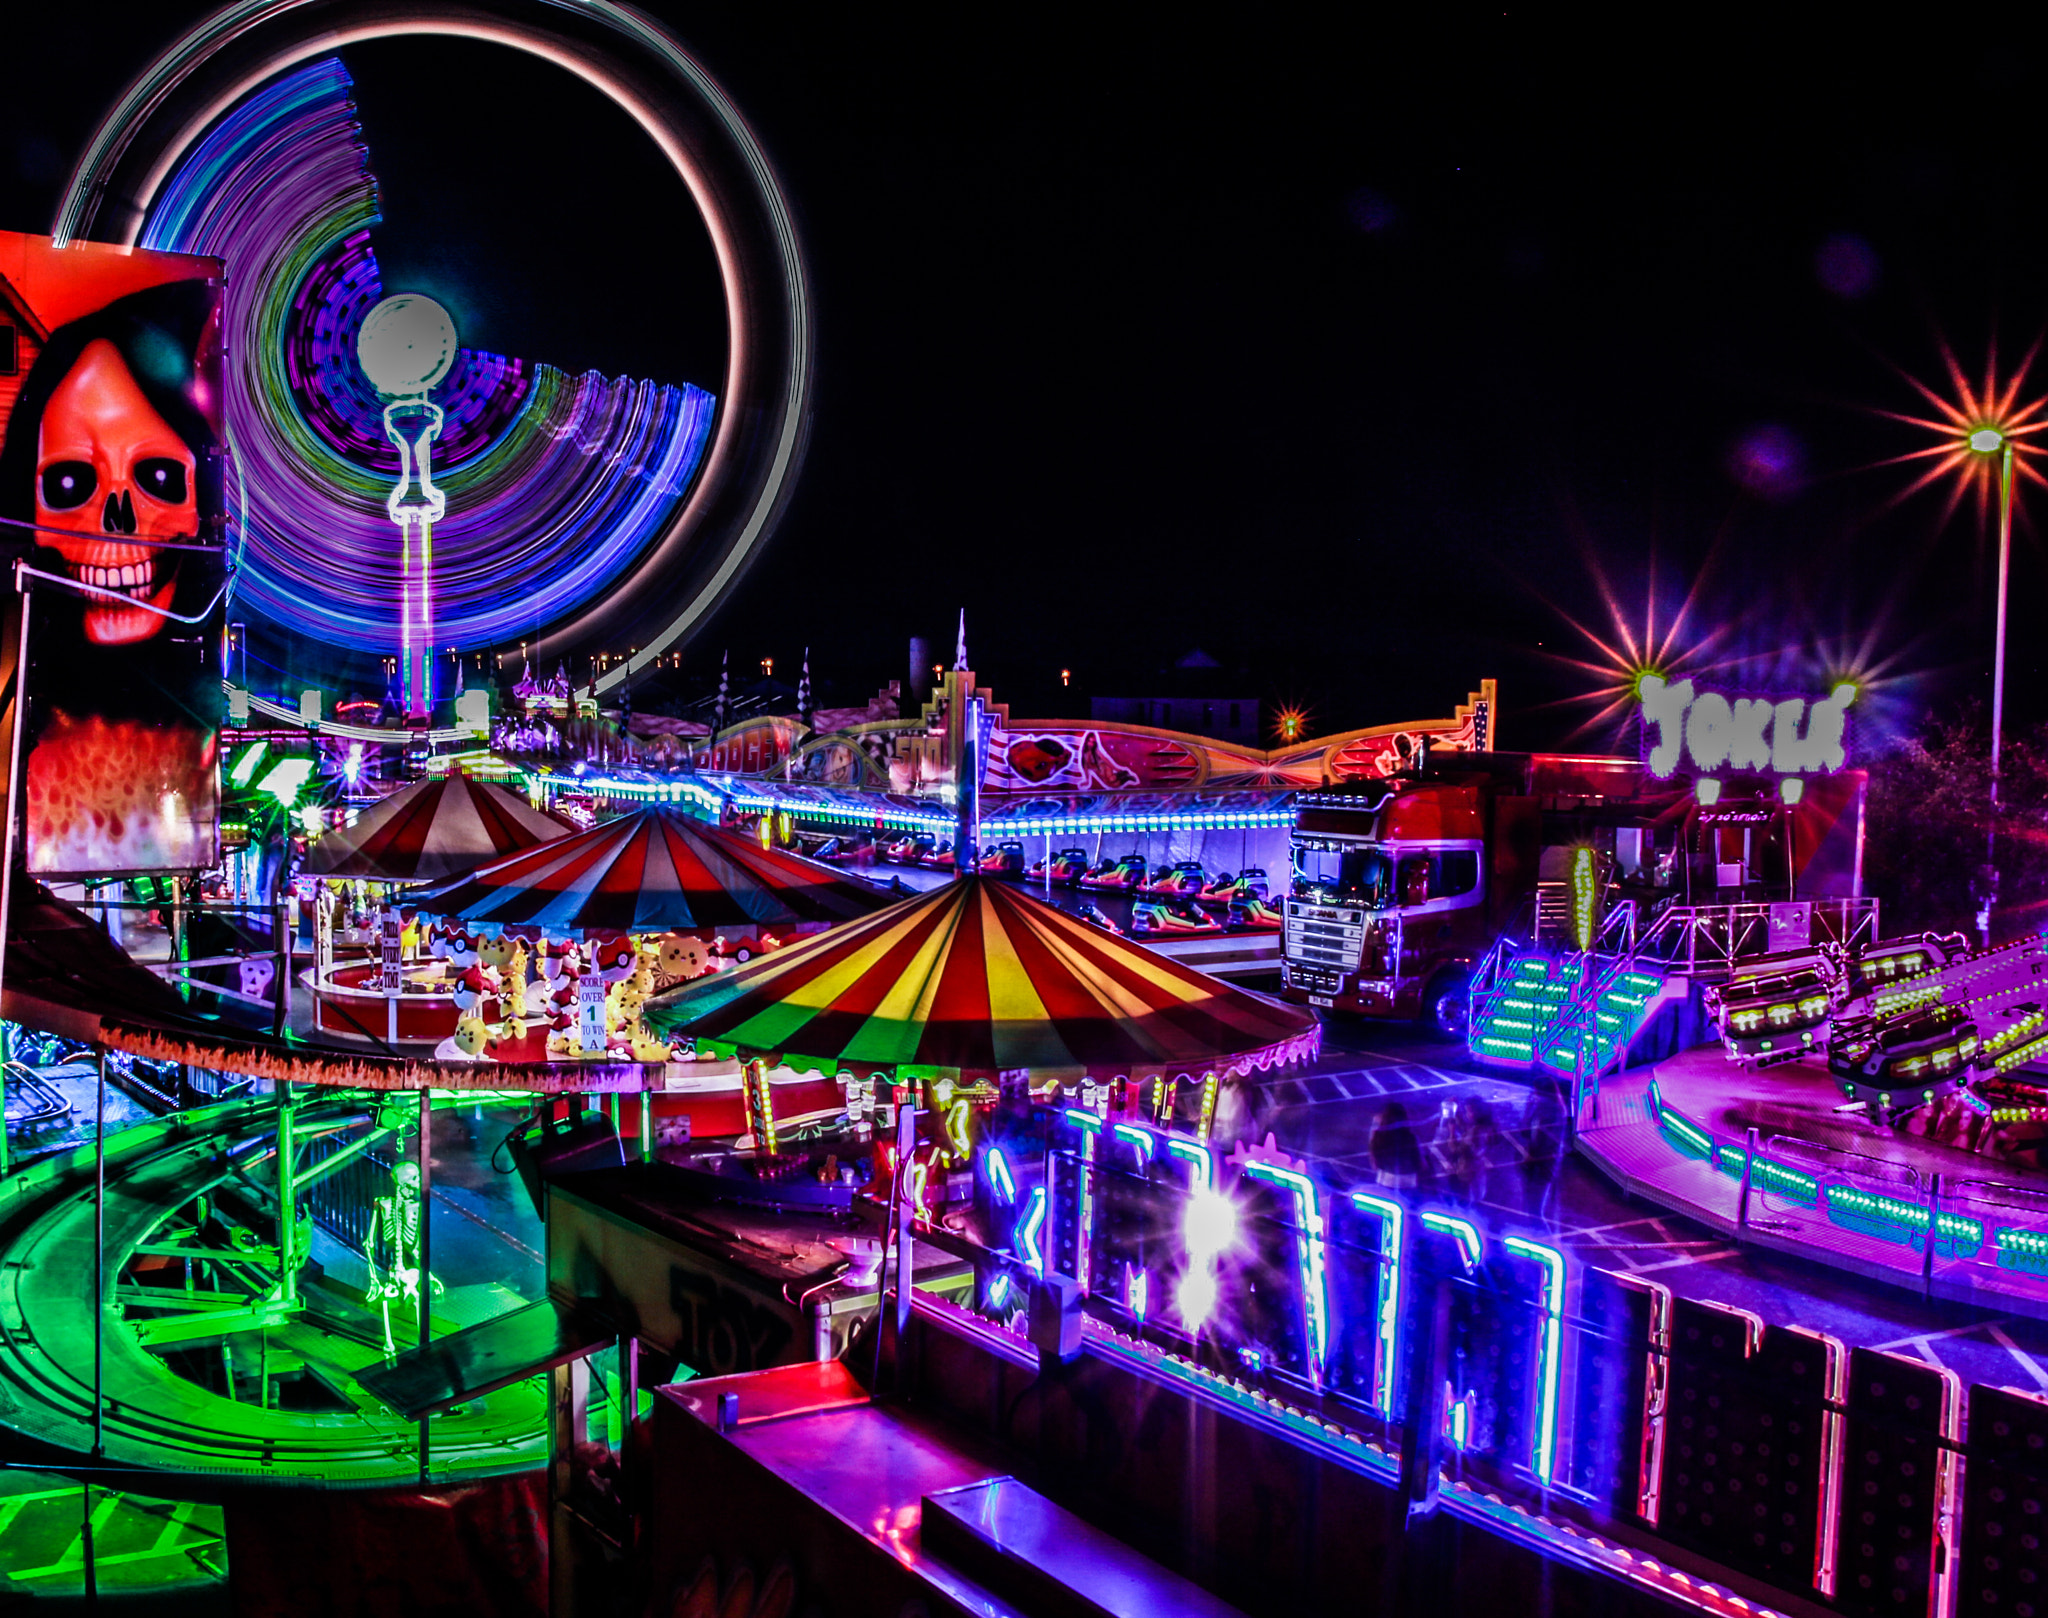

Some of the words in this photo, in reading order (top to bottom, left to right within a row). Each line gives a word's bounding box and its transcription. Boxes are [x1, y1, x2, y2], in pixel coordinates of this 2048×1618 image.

[1641, 677, 1847, 779] JOKER
[890, 736, 942, 784] 500
[1308, 908, 1338, 920] SCANIA
[580, 977, 604, 988] SCORE
[581, 992, 604, 1003] OVER
[587, 1005, 596, 1022] 1
[582, 1025, 591, 1036] TO
[592, 1025, 605, 1036] WIN
[589, 1039, 599, 1050] A
[752, 1089, 762, 1111] 3
